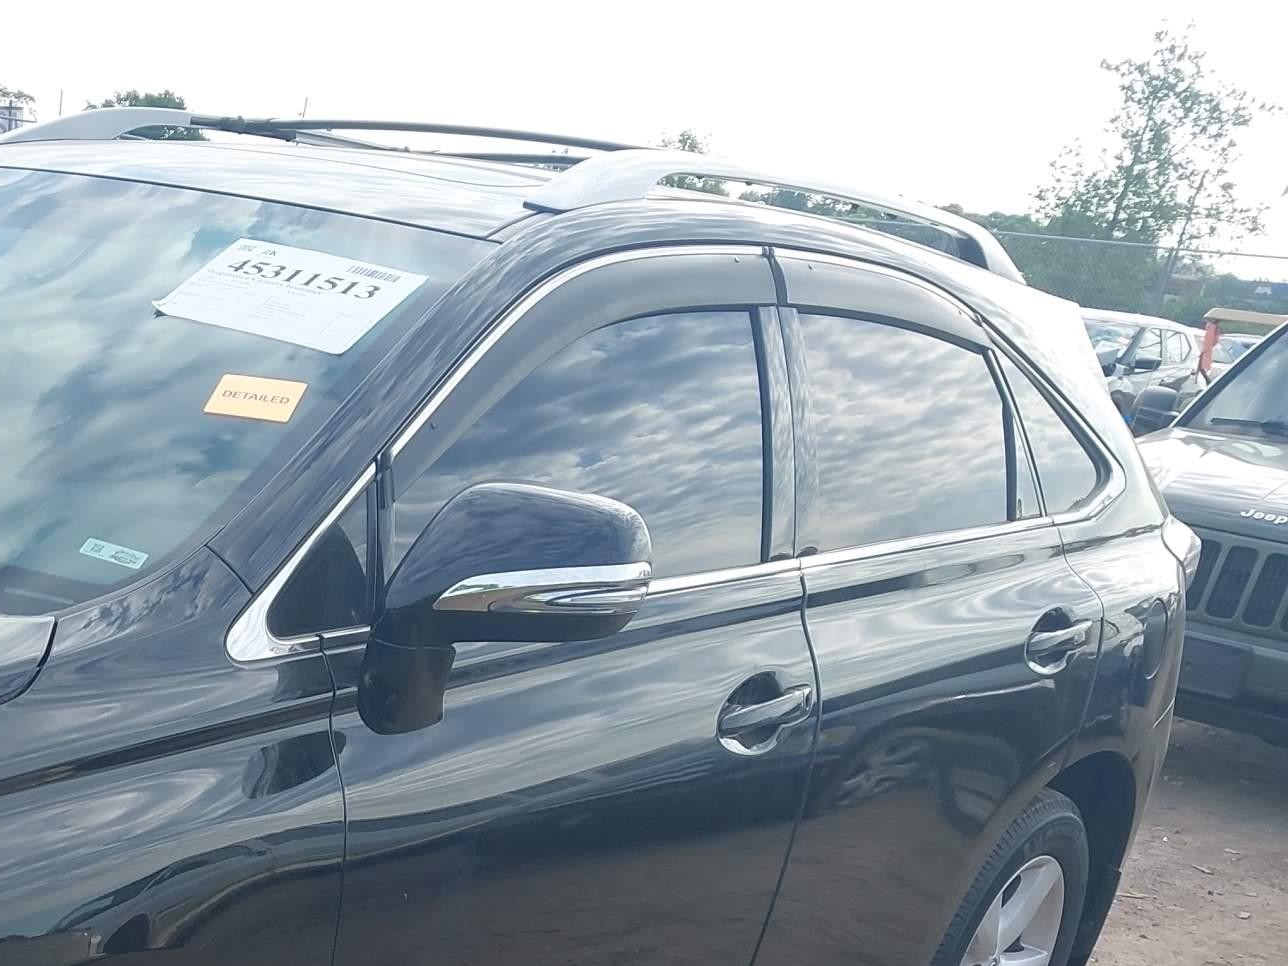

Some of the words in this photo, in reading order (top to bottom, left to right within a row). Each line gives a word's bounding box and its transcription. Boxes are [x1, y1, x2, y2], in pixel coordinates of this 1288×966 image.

[228, 259, 381, 299] 45311513
[221, 390, 291, 405] DETAILED
[1240, 509, 1288, 525] Jeep
